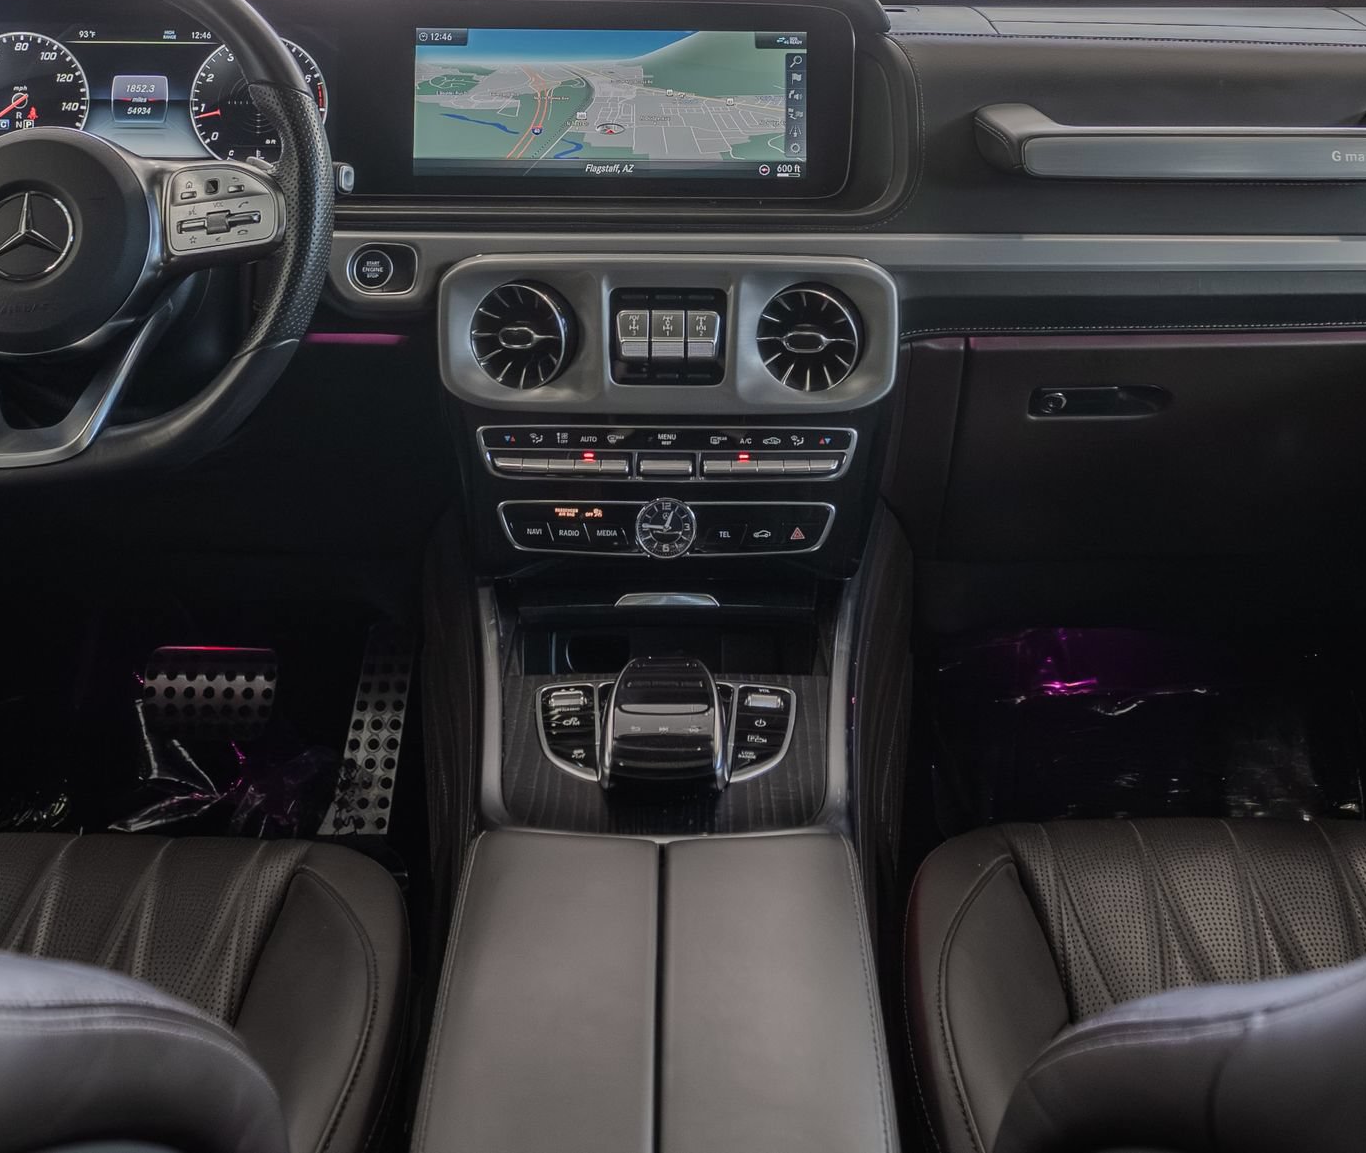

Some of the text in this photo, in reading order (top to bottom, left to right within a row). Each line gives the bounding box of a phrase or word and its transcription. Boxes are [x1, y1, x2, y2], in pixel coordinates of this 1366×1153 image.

[191, 31, 212, 39] 12:46
[430, 32, 452, 41] 12:46
[14, 42, 29, 51] 80
[40, 52, 58, 61] 100
[56, 73, 74, 82] 120
[206, 74, 214, 82] 2
[126, 84, 155, 93] 1852.3
[61, 102, 79, 111] 140
[200, 104, 206, 112] 1
[211, 132, 219, 141] 0
[1331, 150, 1342, 162] G
[585, 163, 635, 174] Flagstaff, AZ
[777, 164, 801, 172] 600 ft
